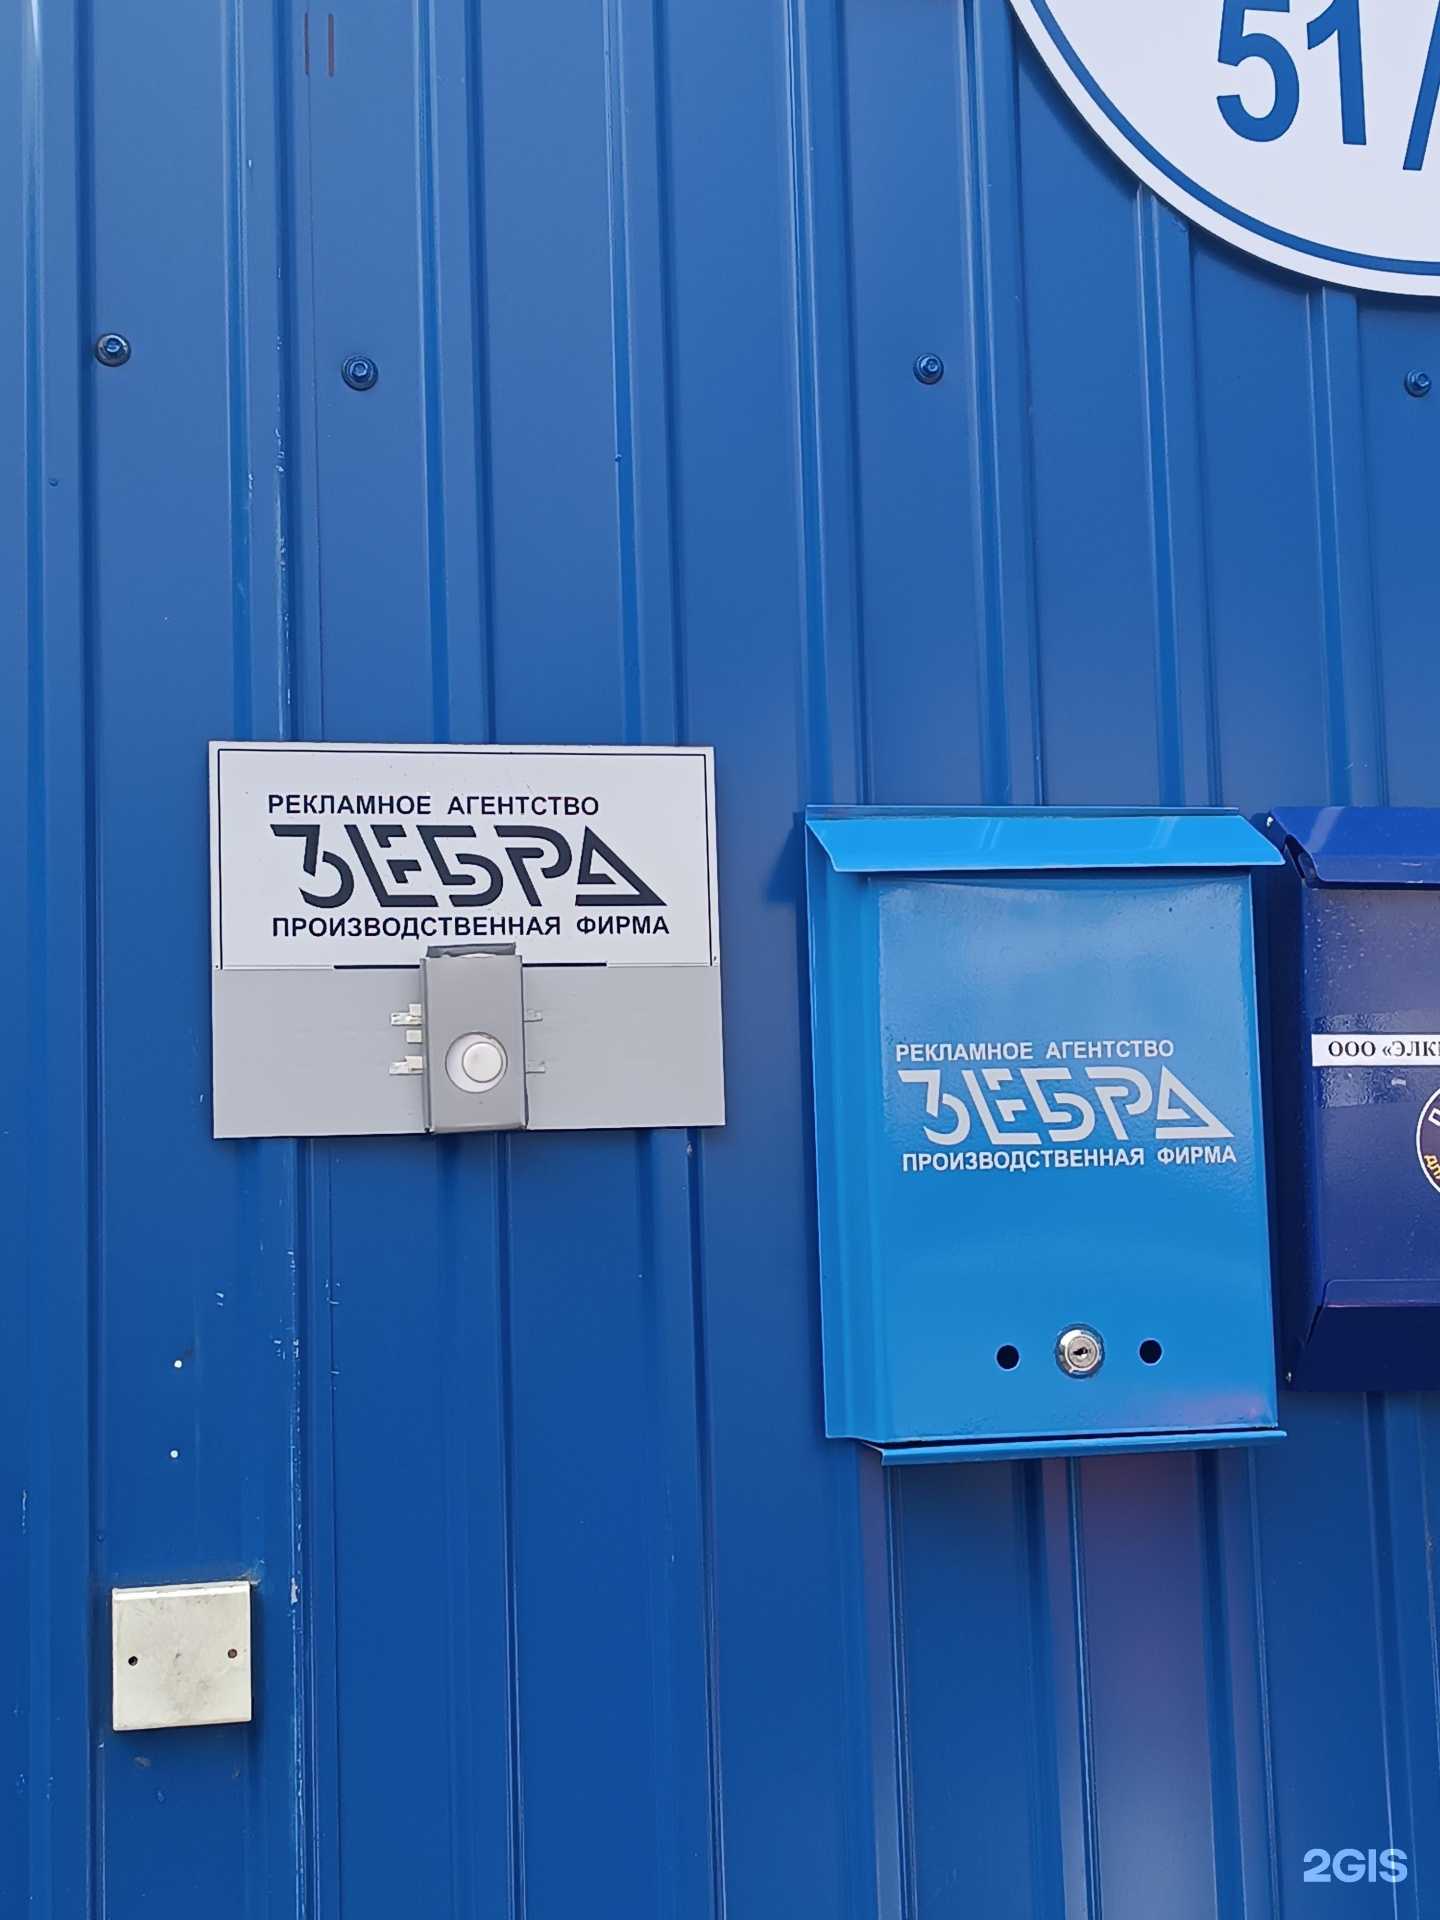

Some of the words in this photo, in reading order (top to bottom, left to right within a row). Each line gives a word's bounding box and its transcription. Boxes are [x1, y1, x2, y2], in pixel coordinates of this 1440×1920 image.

[268, 794, 432, 815] РЕКЛАМНОЕ
[447, 796, 600, 816] АГЕНТСТВО
[270, 823, 668, 908] ЗЕБРА
[272, 916, 561, 940] ПРОИЗВОДСТВЕННАЯ
[575, 915, 670, 936] ФИРМА
[895, 1041, 1034, 1062] РЕКЛАМНОЕ
[1045, 1039, 1175, 1060] АГЕНТСТВО
[1328, 1040, 1376, 1057] ООО
[897, 1064, 1235, 1146] ЗЕБРА
[902, 1147, 1145, 1173] ПРОИЗВОДСТВЕННАЯ
[1157, 1145, 1237, 1166] ФИРМА
